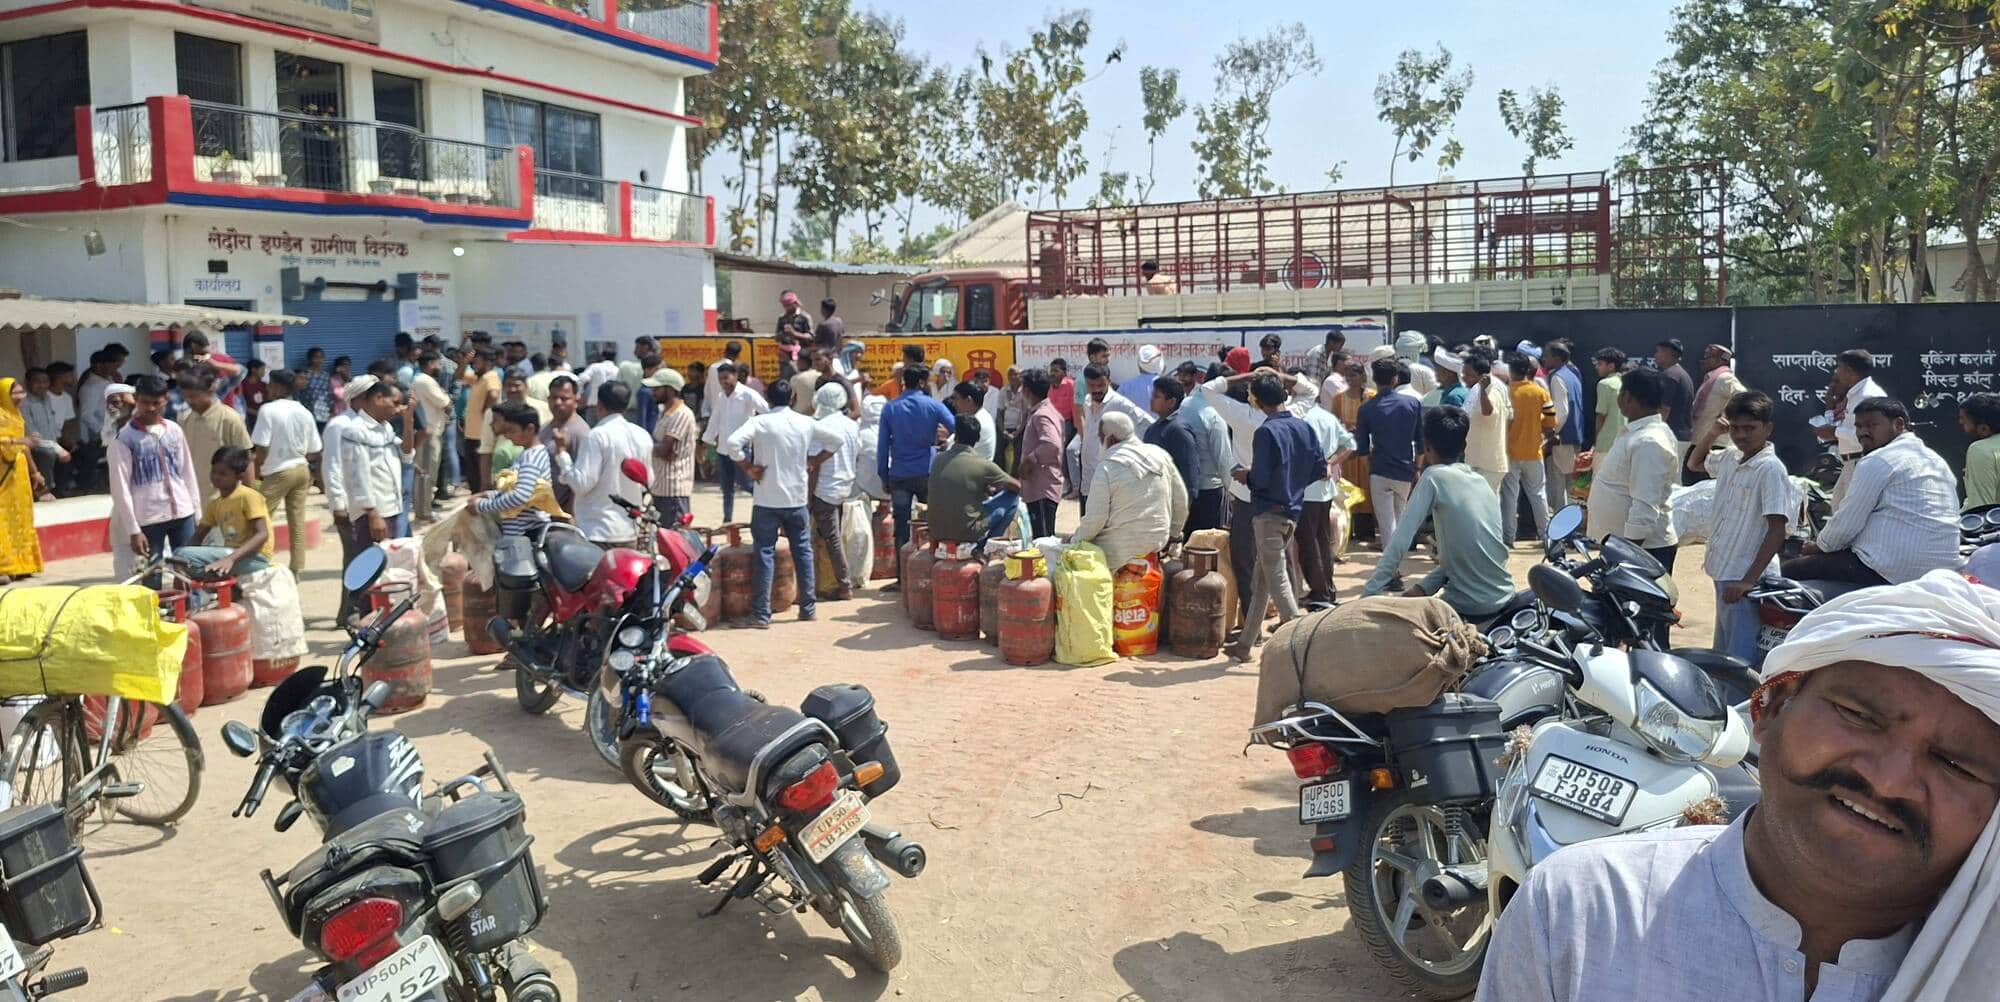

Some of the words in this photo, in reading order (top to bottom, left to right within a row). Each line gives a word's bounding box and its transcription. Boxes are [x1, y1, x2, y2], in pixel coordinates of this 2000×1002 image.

[310, 233, 357, 255] ग्रामीण
[363, 234, 409, 257] वितरक
[1772, 350, 1837, 373] साप्ताहिक
[1920, 350, 1958, 369] बुकिंग
[1922, 370, 1959, 388] मिस्ड
[1963, 370, 1994, 389] कॉल
[1585, 744, 1629, 765] HONDA
[1562, 763, 1624, 798] UP50B
[1310, 783, 1344, 802] UP50D
[1553, 778, 1615, 813] F3884
[1309, 799, 1344, 817] B4969
[469, 914, 496, 937] STAR
[354, 951, 423, 997] UP50AY
